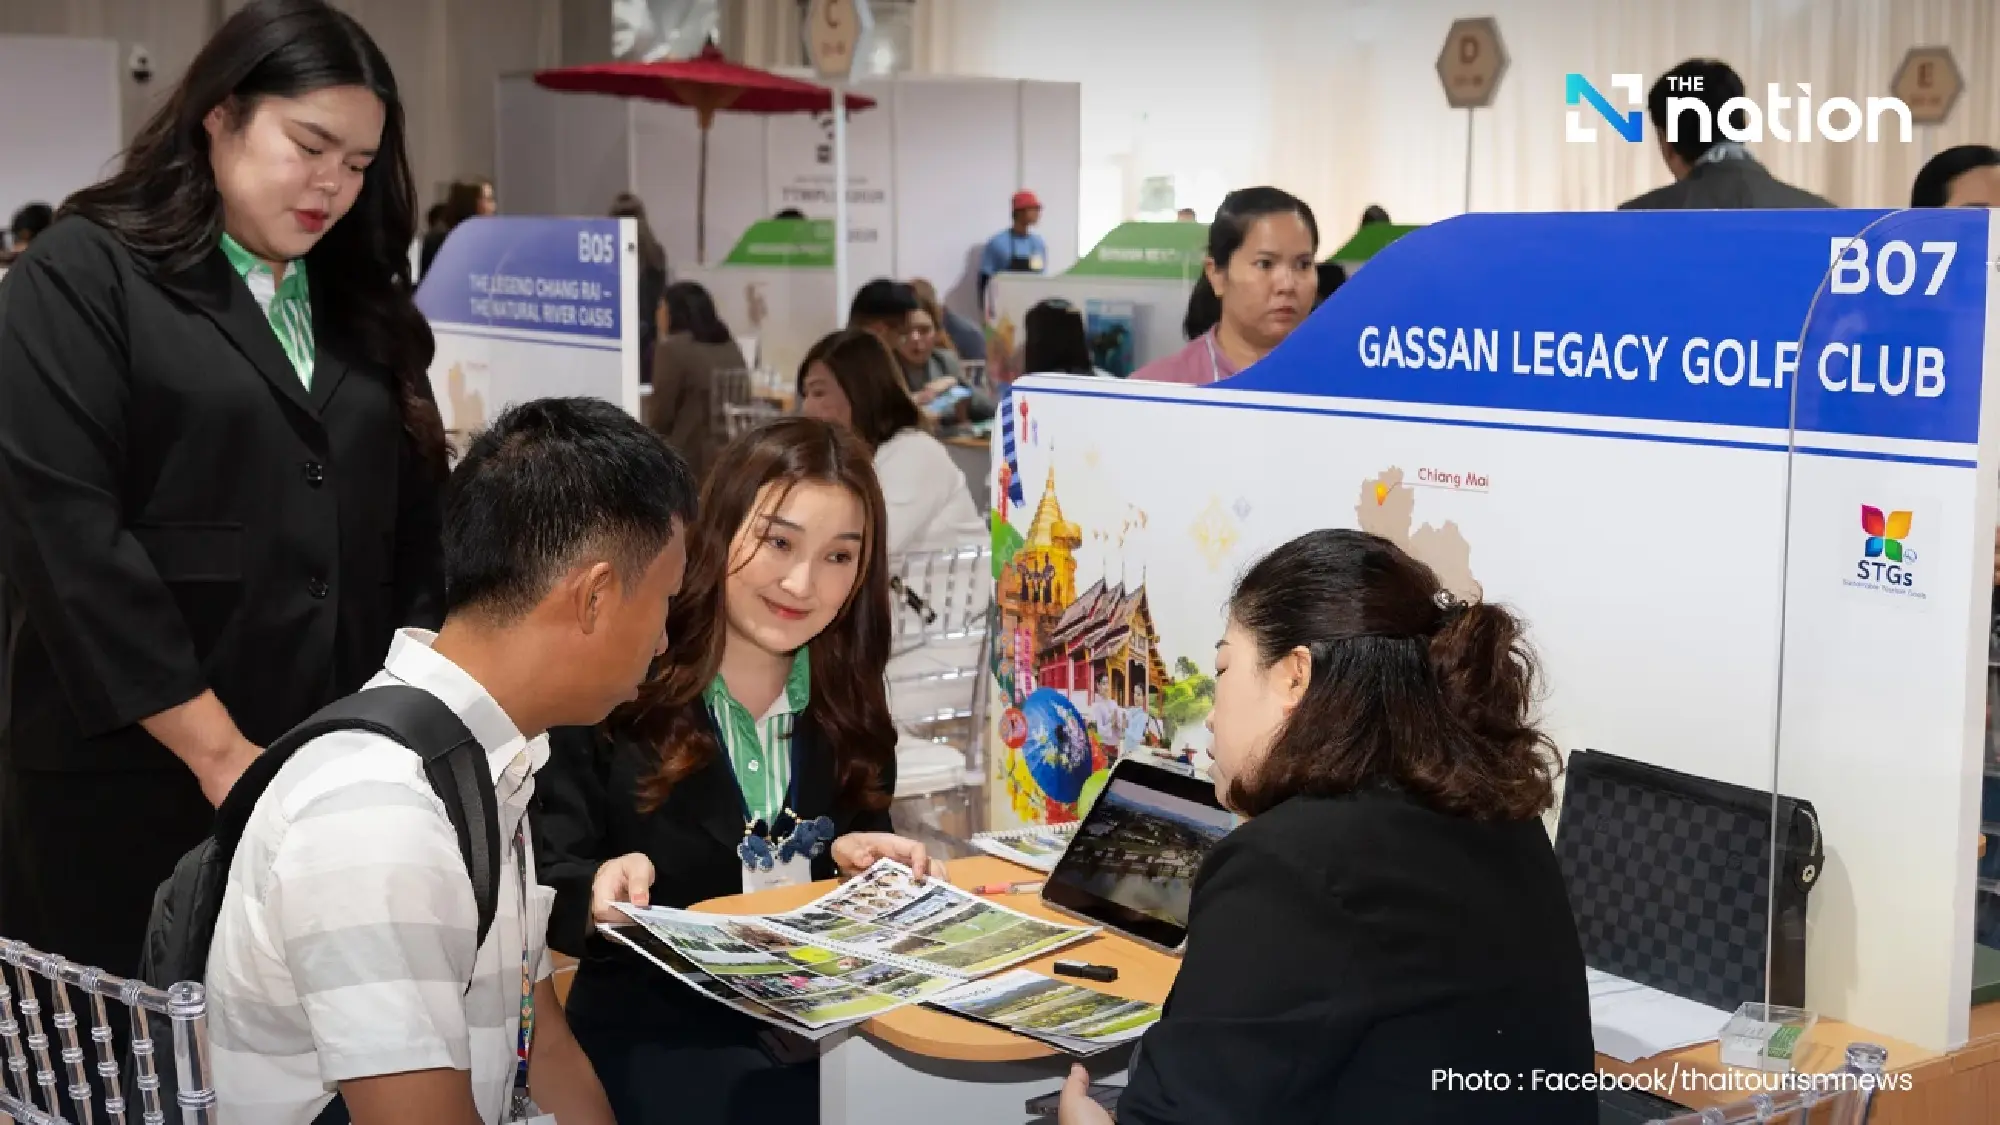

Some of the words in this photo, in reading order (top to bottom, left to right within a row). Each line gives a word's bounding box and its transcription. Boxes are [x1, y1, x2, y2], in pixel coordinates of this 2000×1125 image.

[1460, 36, 1478, 64] D
[578, 231, 614, 263] B05
[1830, 237, 1958, 296] B07
[536, 277, 579, 300] CHIANG
[490, 299, 540, 323] NATURAL
[542, 303, 577, 326] RIVER
[579, 305, 613, 328] OASIS
[1359, 325, 1499, 373] GASSAN
[1512, 331, 1668, 381] LEGACY
[1682, 337, 1799, 390] GOLF
[1817, 342, 1947, 398] CLUB
[1418, 467, 1460, 488] Chiang
[1465, 471, 1490, 487] Mai
[1857, 559, 1913, 587] STGs
